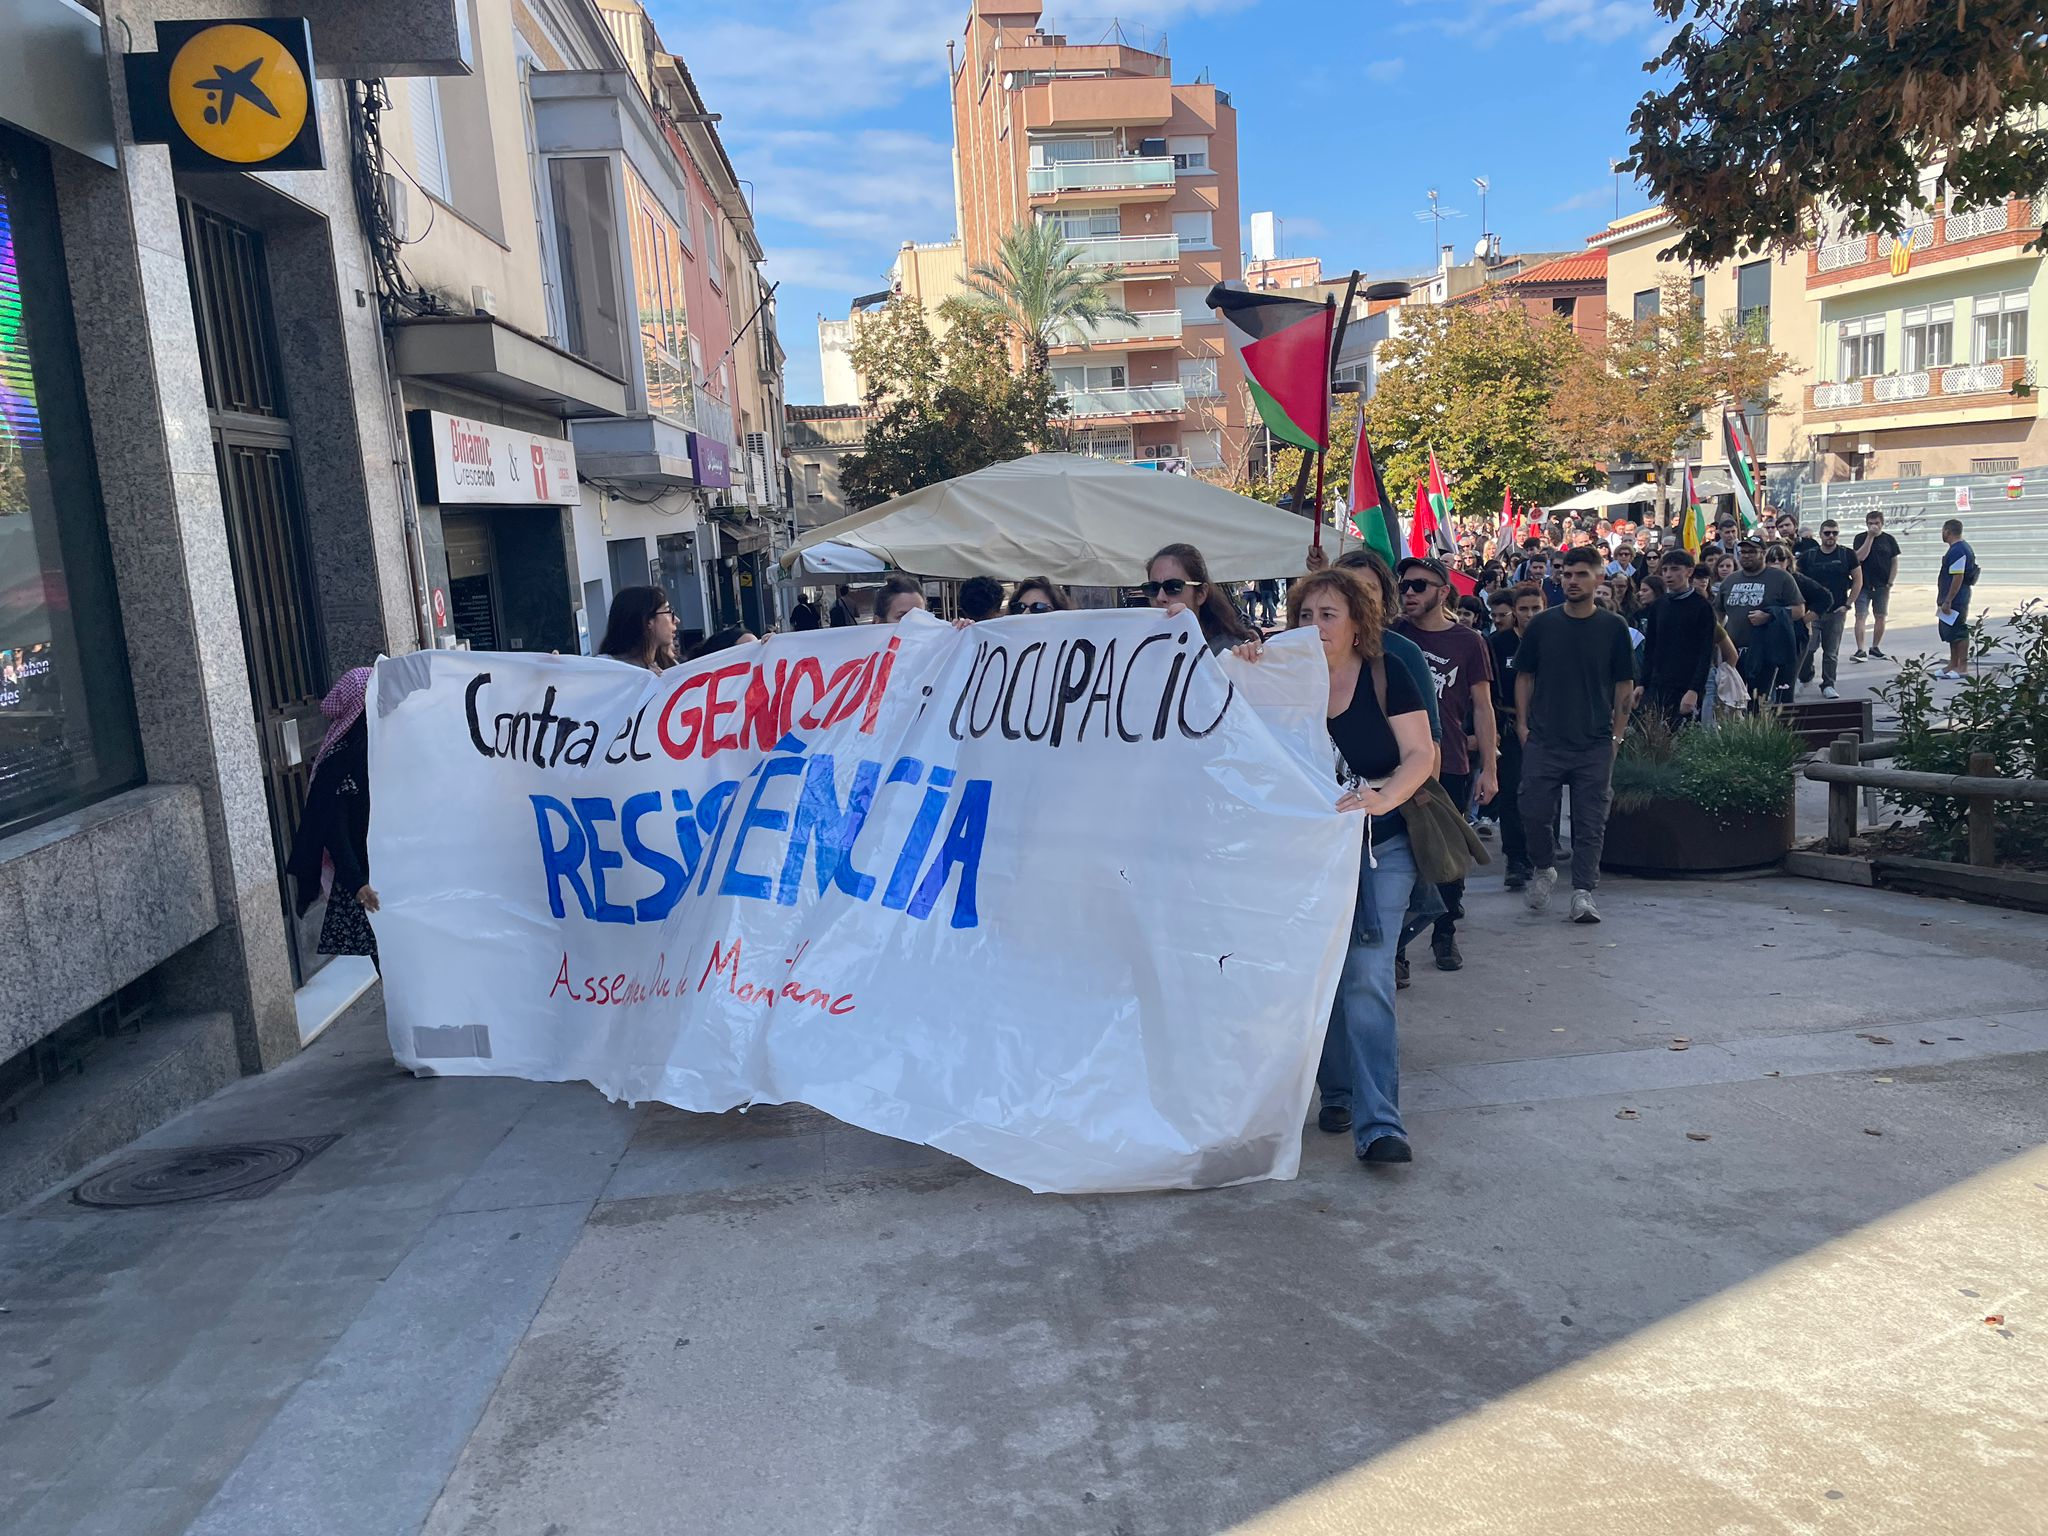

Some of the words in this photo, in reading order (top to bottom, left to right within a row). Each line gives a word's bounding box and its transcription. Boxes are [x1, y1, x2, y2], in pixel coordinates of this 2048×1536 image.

[1731, 582, 1765, 593] BARCELONA
[465, 672, 601, 769] Contra
[604, 692, 657, 764] el
